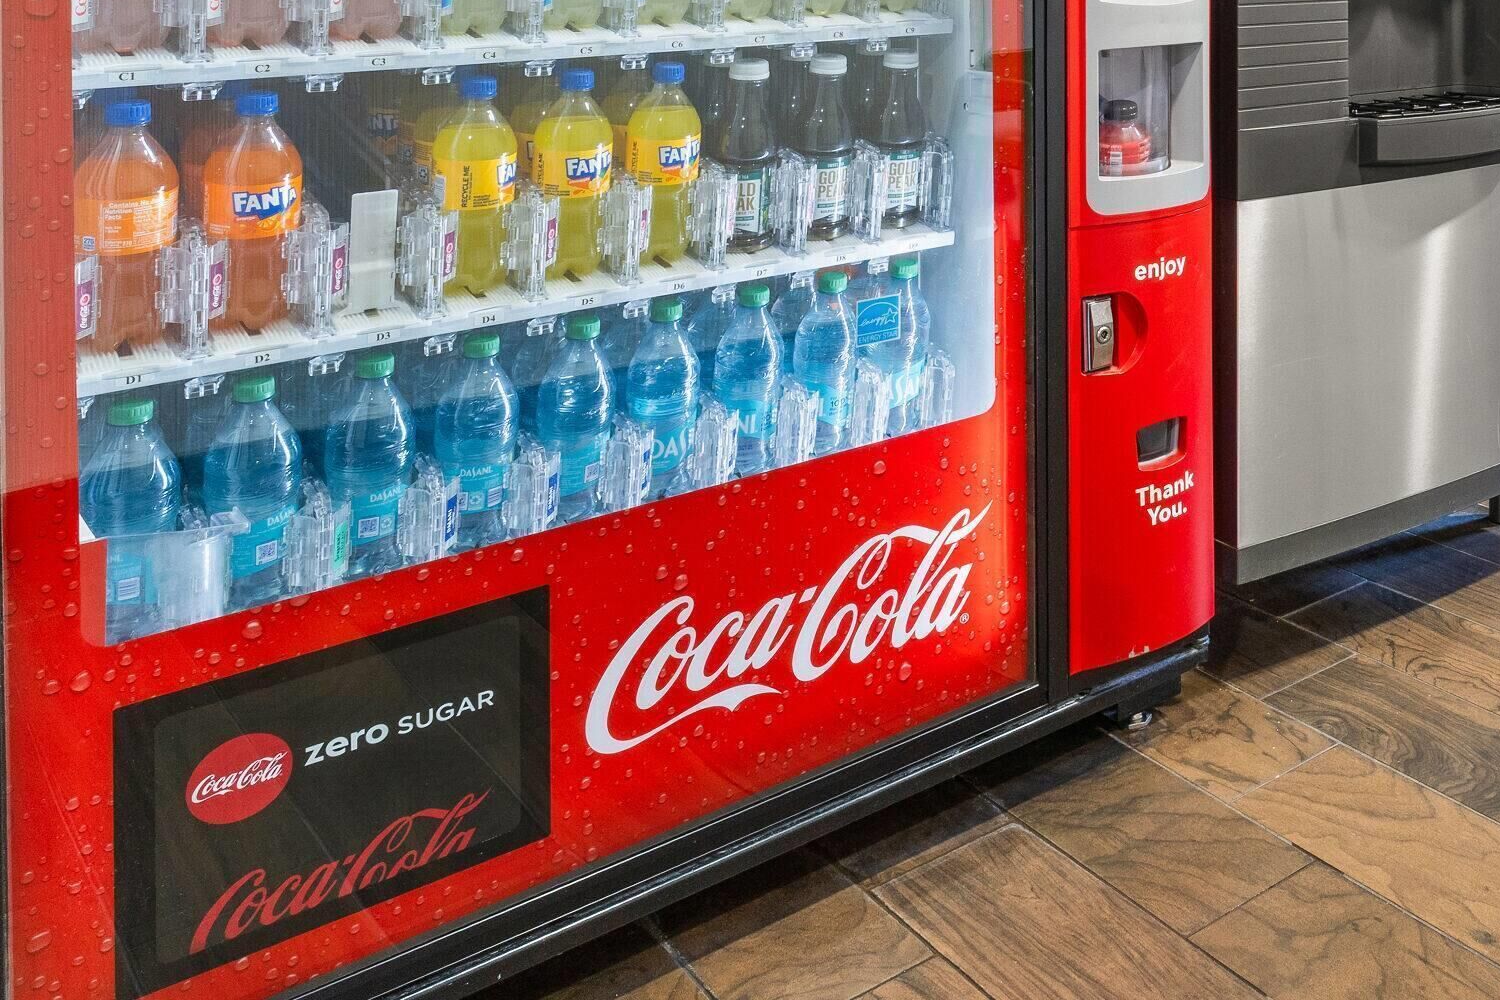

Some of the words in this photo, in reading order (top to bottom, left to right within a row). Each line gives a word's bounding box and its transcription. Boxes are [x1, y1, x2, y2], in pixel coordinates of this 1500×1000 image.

[833, 31, 844, 39] C8
[483, 51, 496, 59] C4
[255, 64, 270, 73] C2
[372, 58, 386, 66] C3
[119, 72, 135, 81] C1
[462, 166, 470, 176] ME
[889, 162, 916, 175] GOLD
[888, 176, 915, 189] PEAK
[462, 177, 470, 207] RECYCLE
[739, 183, 756, 197] LD
[233, 186, 296, 213] FANTA
[736, 198, 755, 211] AK
[1134, 255, 1186, 281] enjoy
[673, 282, 685, 290] D6
[581, 298, 594, 306] D5
[482, 315, 496, 323] D4
[376, 332, 391, 341] D3
[859, 333, 882, 344] ENERGY
[883, 330, 898, 339] STAR
[254, 353, 270, 363] D2
[126, 375, 142, 384] D1
[1135, 470, 1194, 507] Thank
[1147, 500, 1187, 526] You.
[585, 499, 993, 754] Coca-Cola
[305, 724, 389, 766] zero
[397, 690, 495, 735] SUGAR
[191, 750, 288, 803] Coca-Cola
